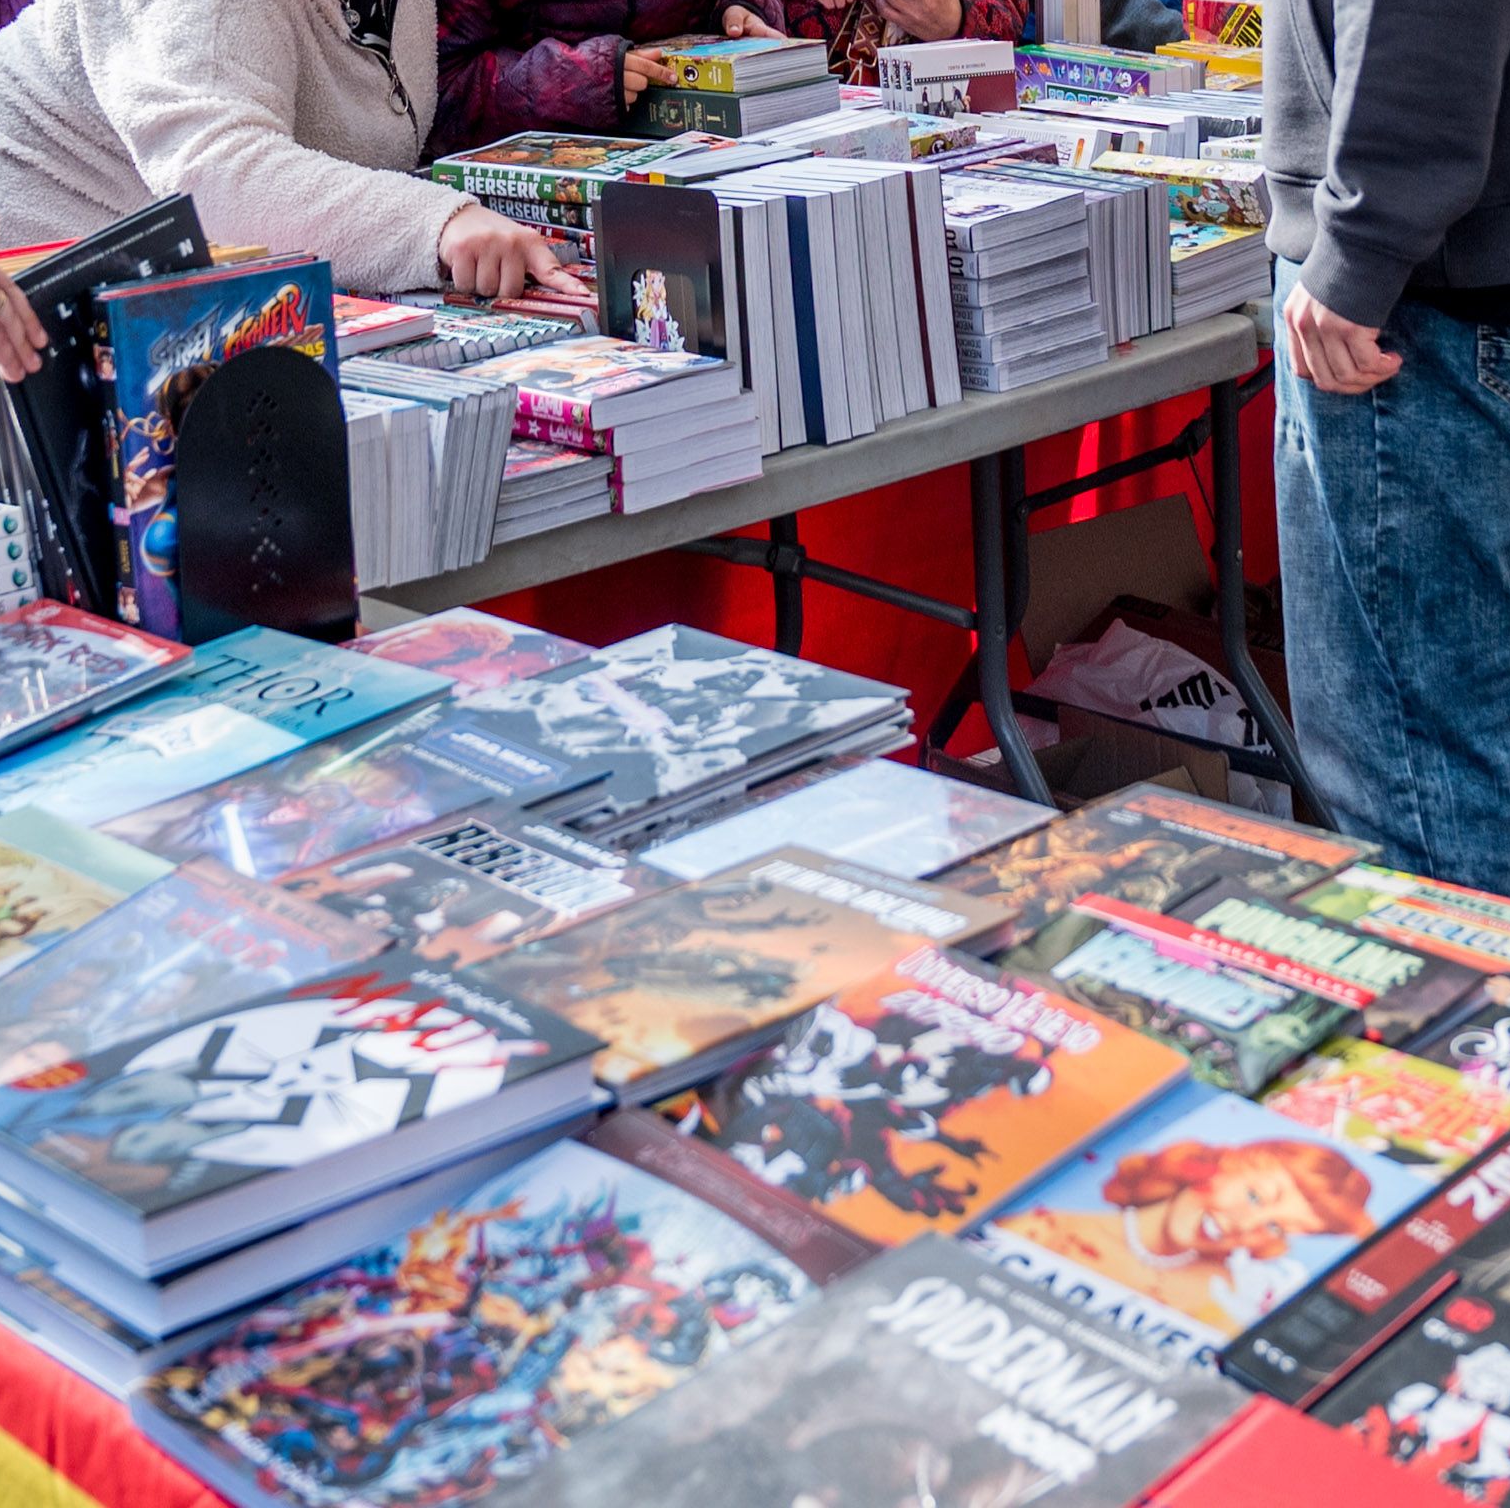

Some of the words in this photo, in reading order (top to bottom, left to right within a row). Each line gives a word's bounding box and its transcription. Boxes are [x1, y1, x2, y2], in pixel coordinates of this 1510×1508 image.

[463, 166, 542, 182] MAXIMUM
[463, 176, 540, 201] BERSERK
[490, 196, 550, 223] BERSERK
[949, 256, 965, 278] 01
[147, 301, 224, 395] STREET
[220, 283, 314, 361] FIGHTER
[531, 394, 564, 416] LAMU
[549, 423, 584, 443] LAMU
[188, 653, 356, 717] THOR
[450, 732, 501, 756] STAR
[495, 748, 552, 775] WARS
[1413, 882, 1510, 918] MARVEL
[871, 1276, 1178, 1456] SPIDERMAN
